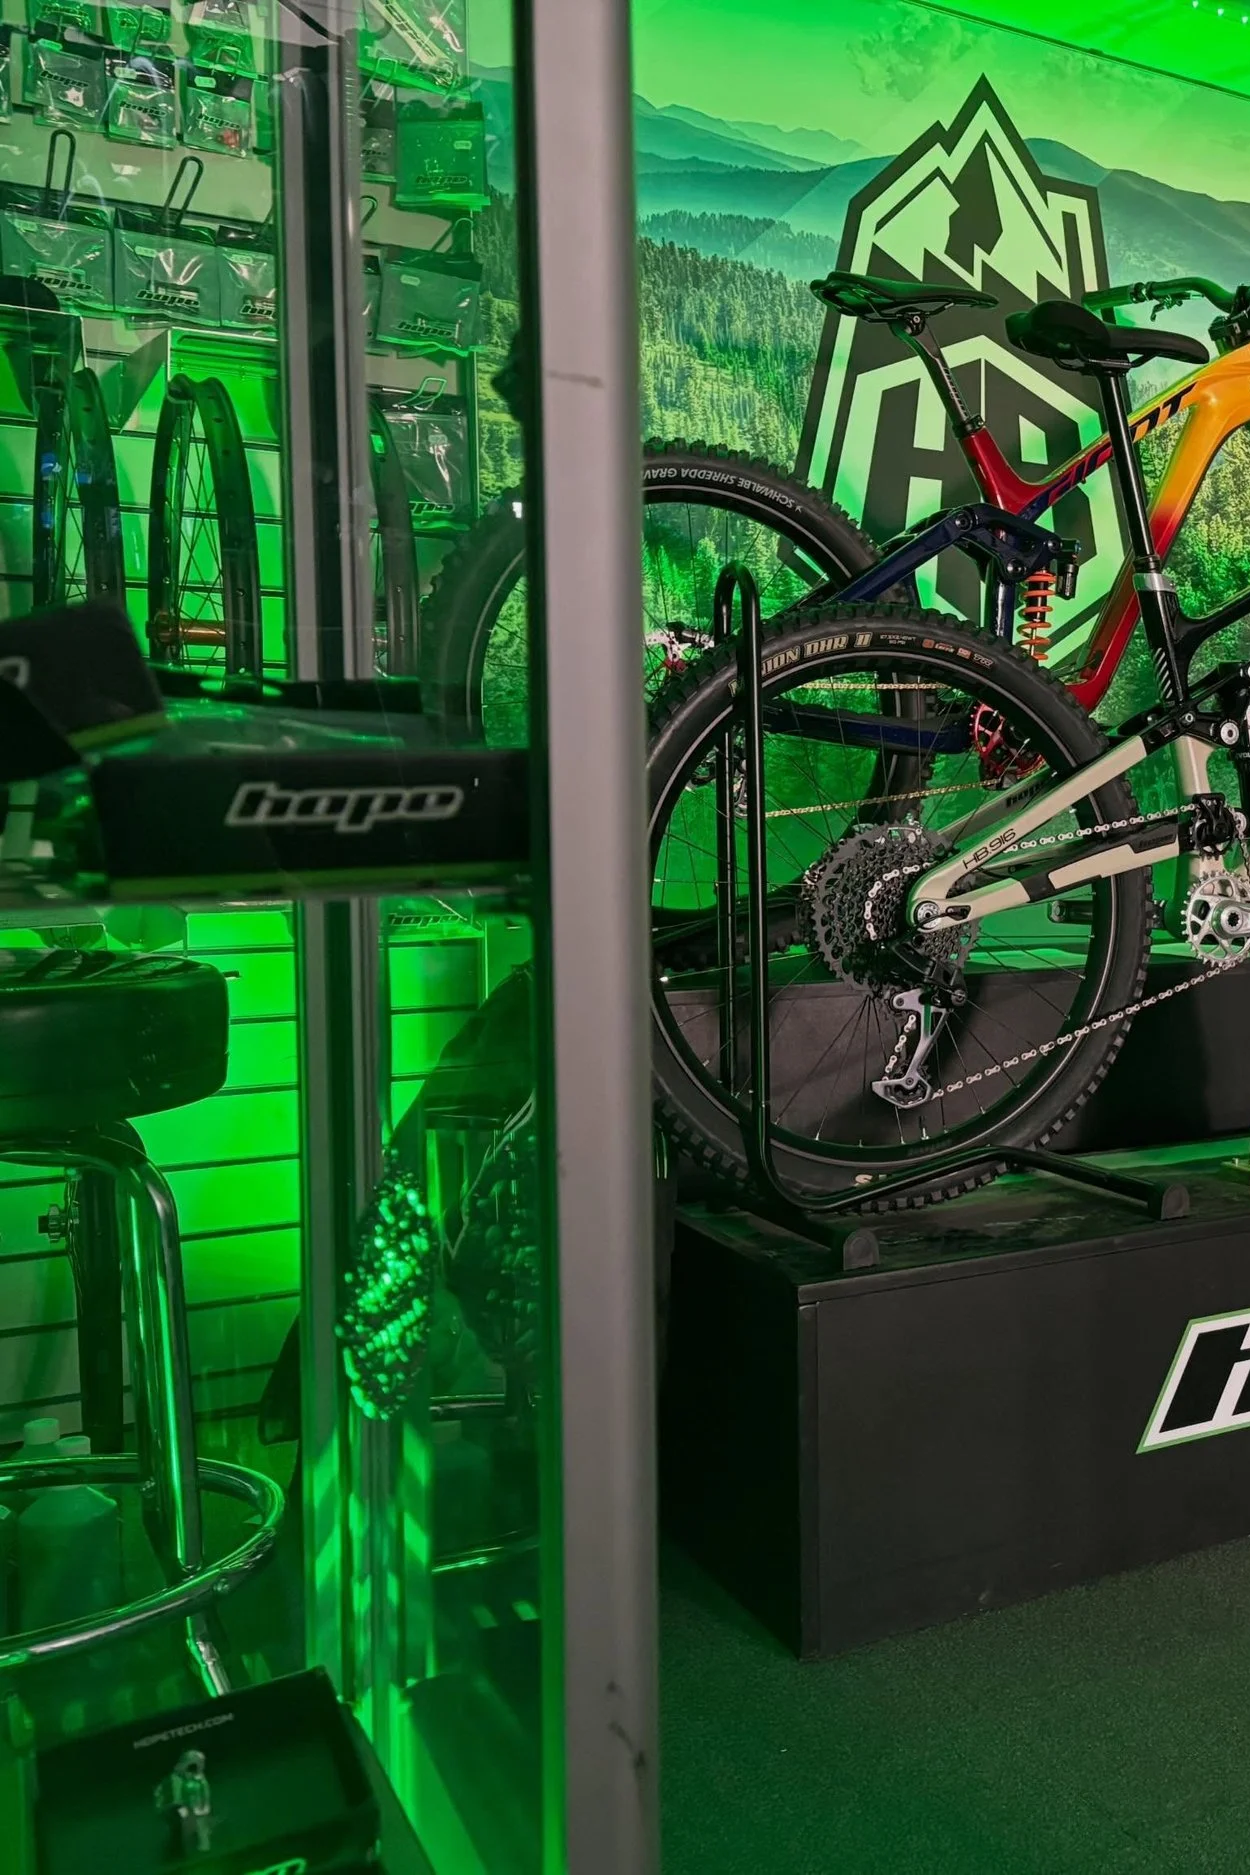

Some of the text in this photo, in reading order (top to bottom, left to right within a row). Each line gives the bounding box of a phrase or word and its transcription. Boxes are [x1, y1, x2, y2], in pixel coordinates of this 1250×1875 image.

[136, 288, 201, 308] hope
[396, 320, 456, 339] hope
[641, 467, 796, 509] SCHWALBE SHREDDA GRAV
[804, 633, 850, 658] DHR
[224, 781, 464, 834] hope
[961, 828, 1017, 870] HB.916
[387, 912, 460, 929] hope
